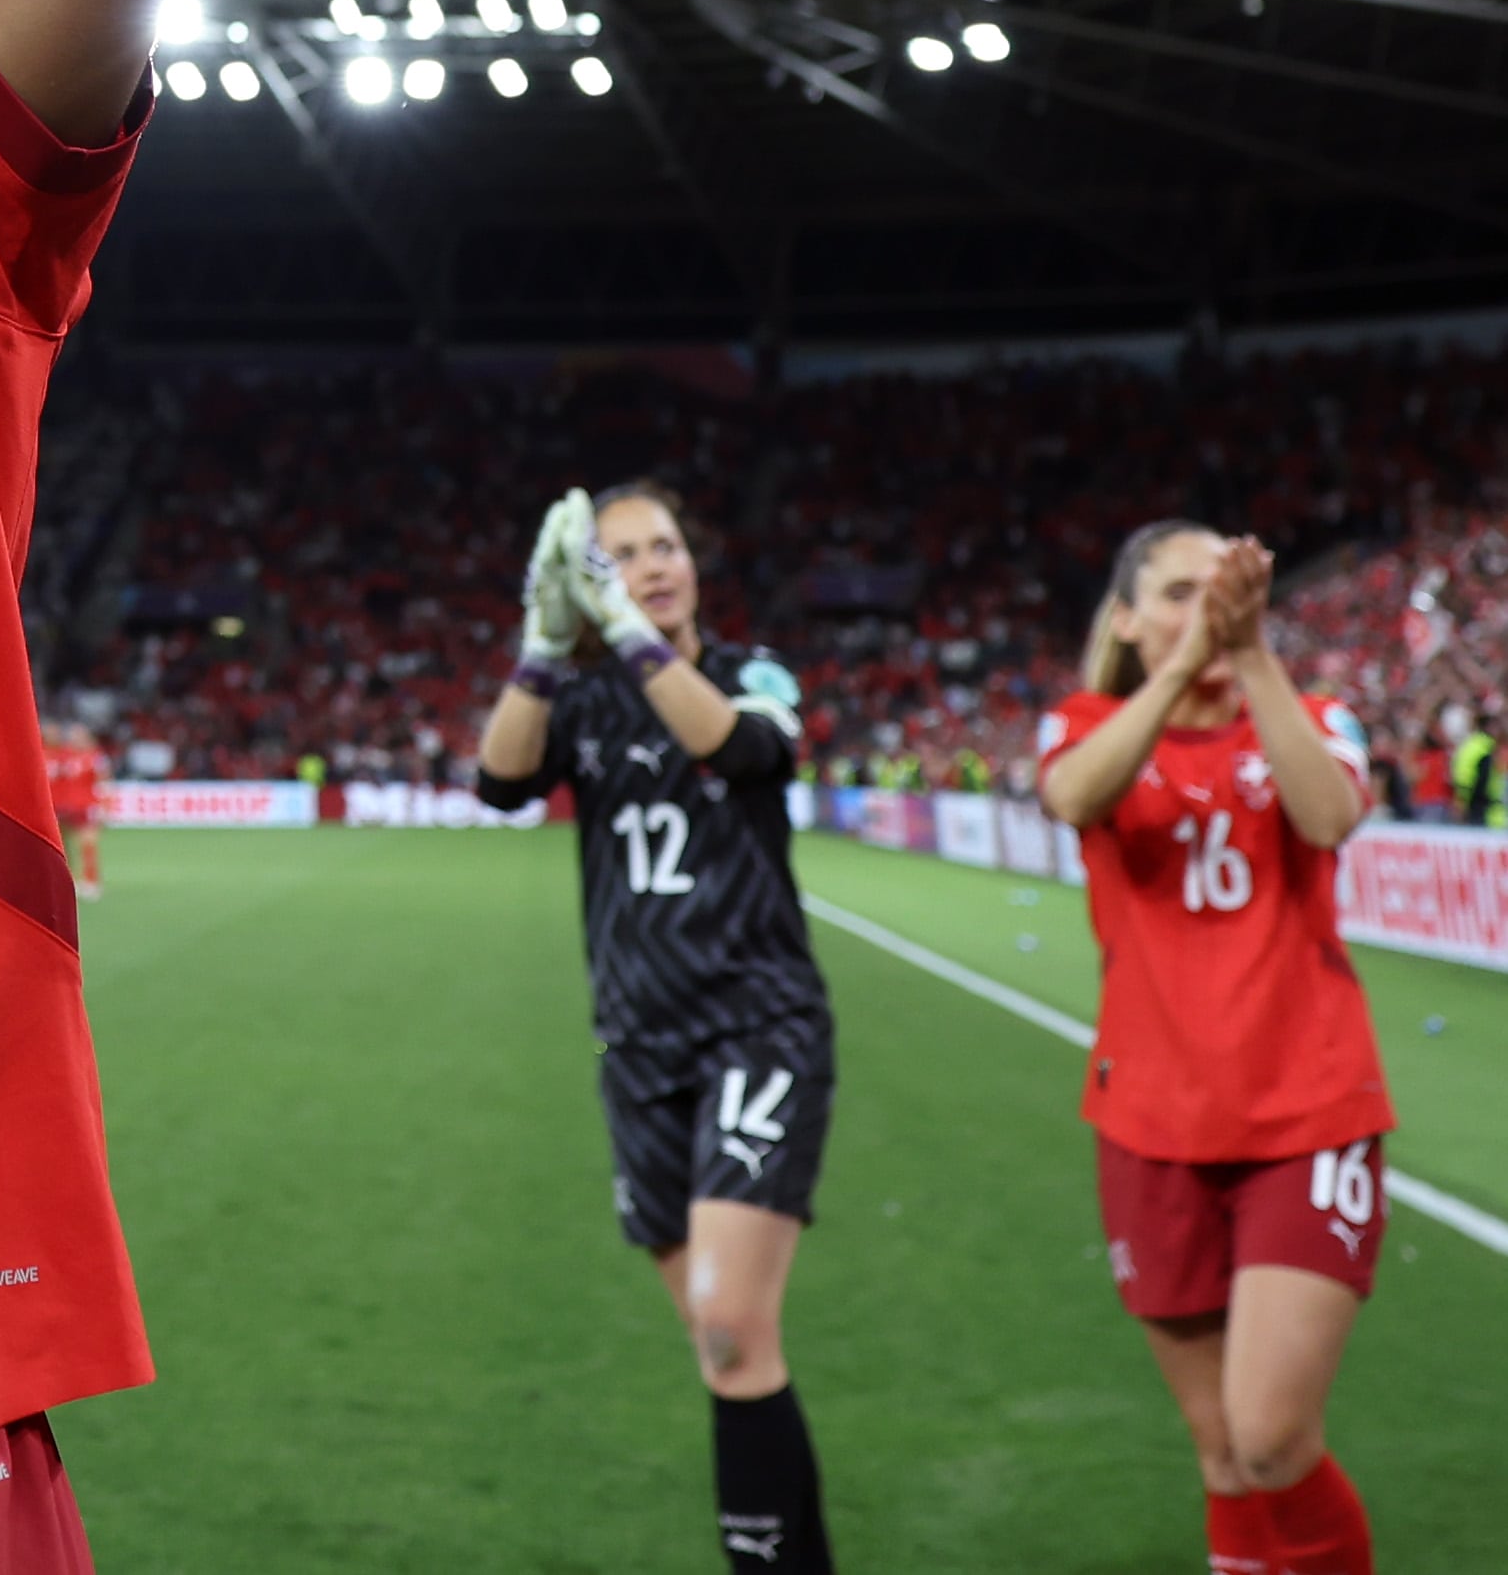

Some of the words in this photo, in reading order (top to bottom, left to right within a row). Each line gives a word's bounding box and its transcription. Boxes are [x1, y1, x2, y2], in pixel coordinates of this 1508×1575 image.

[611, 800, 697, 895] 12
[1172, 810, 1253, 914] 16
[1310, 1139, 1374, 1226] 16
